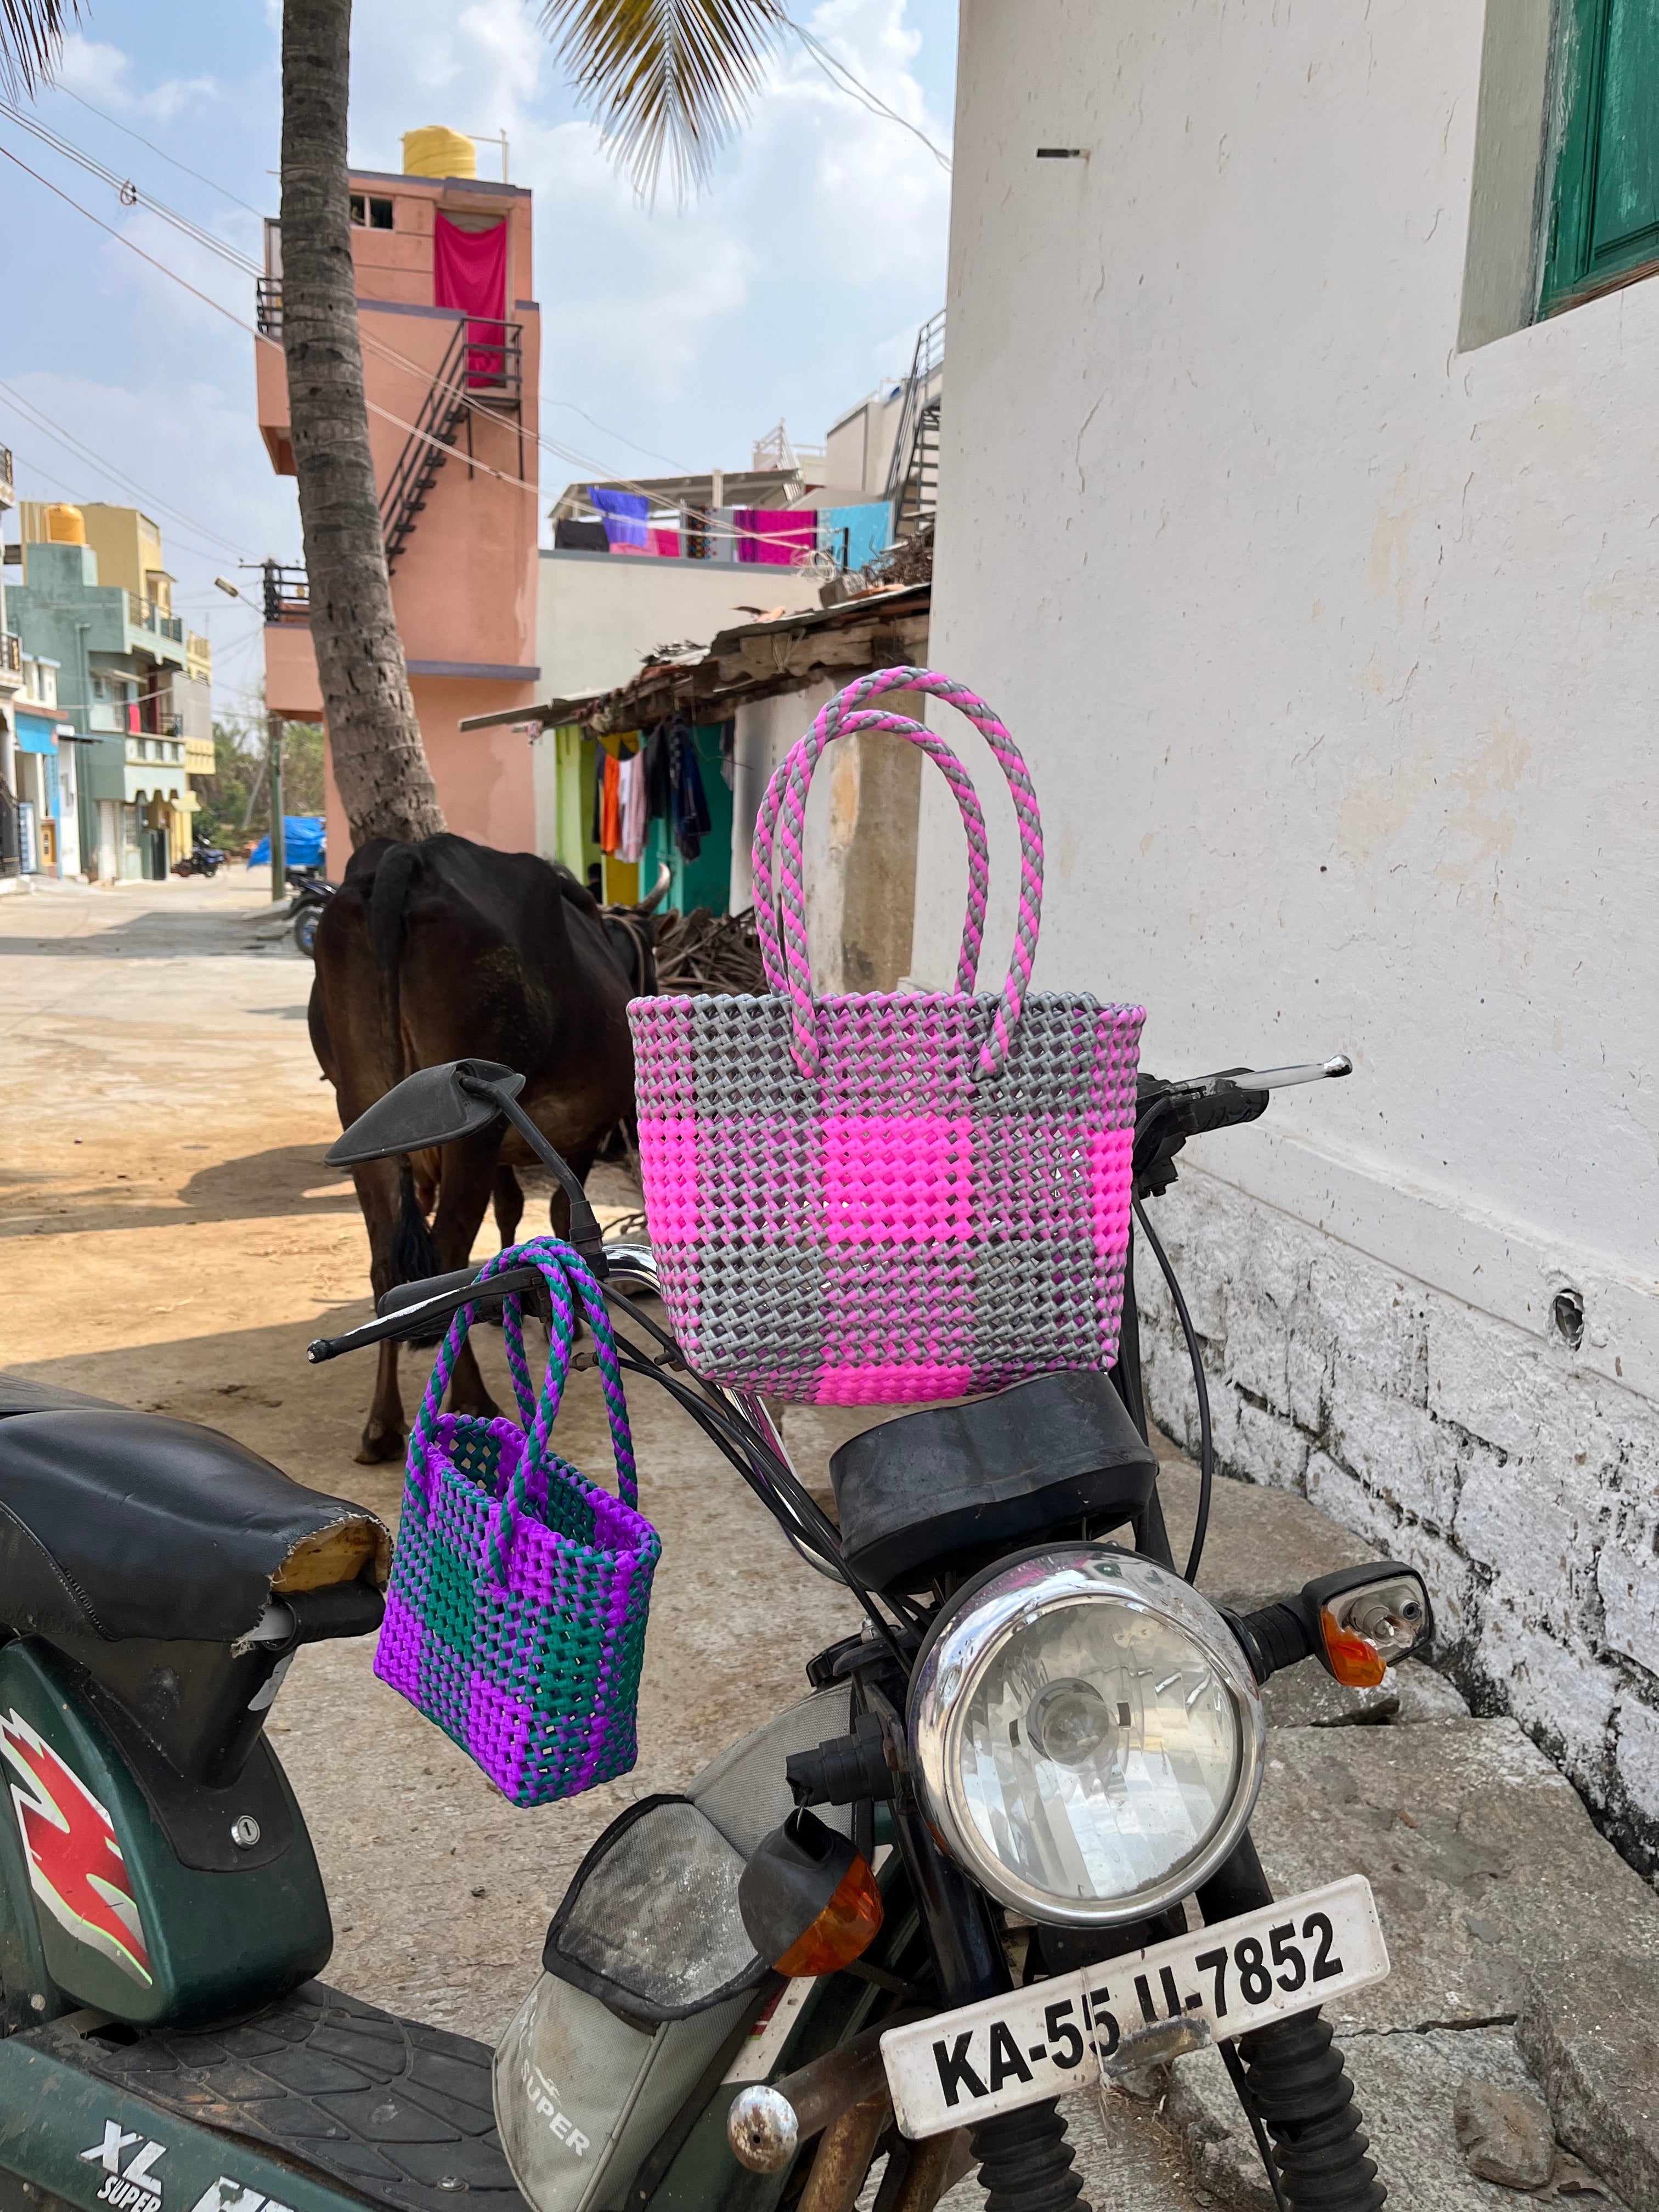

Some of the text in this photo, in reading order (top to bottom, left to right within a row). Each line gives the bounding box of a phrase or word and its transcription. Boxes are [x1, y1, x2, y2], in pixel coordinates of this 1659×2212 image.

[932, 1987, 1120, 2107] KA-55
[80, 2119, 167, 2195] XL
[97, 2175, 161, 2212] SUPER
